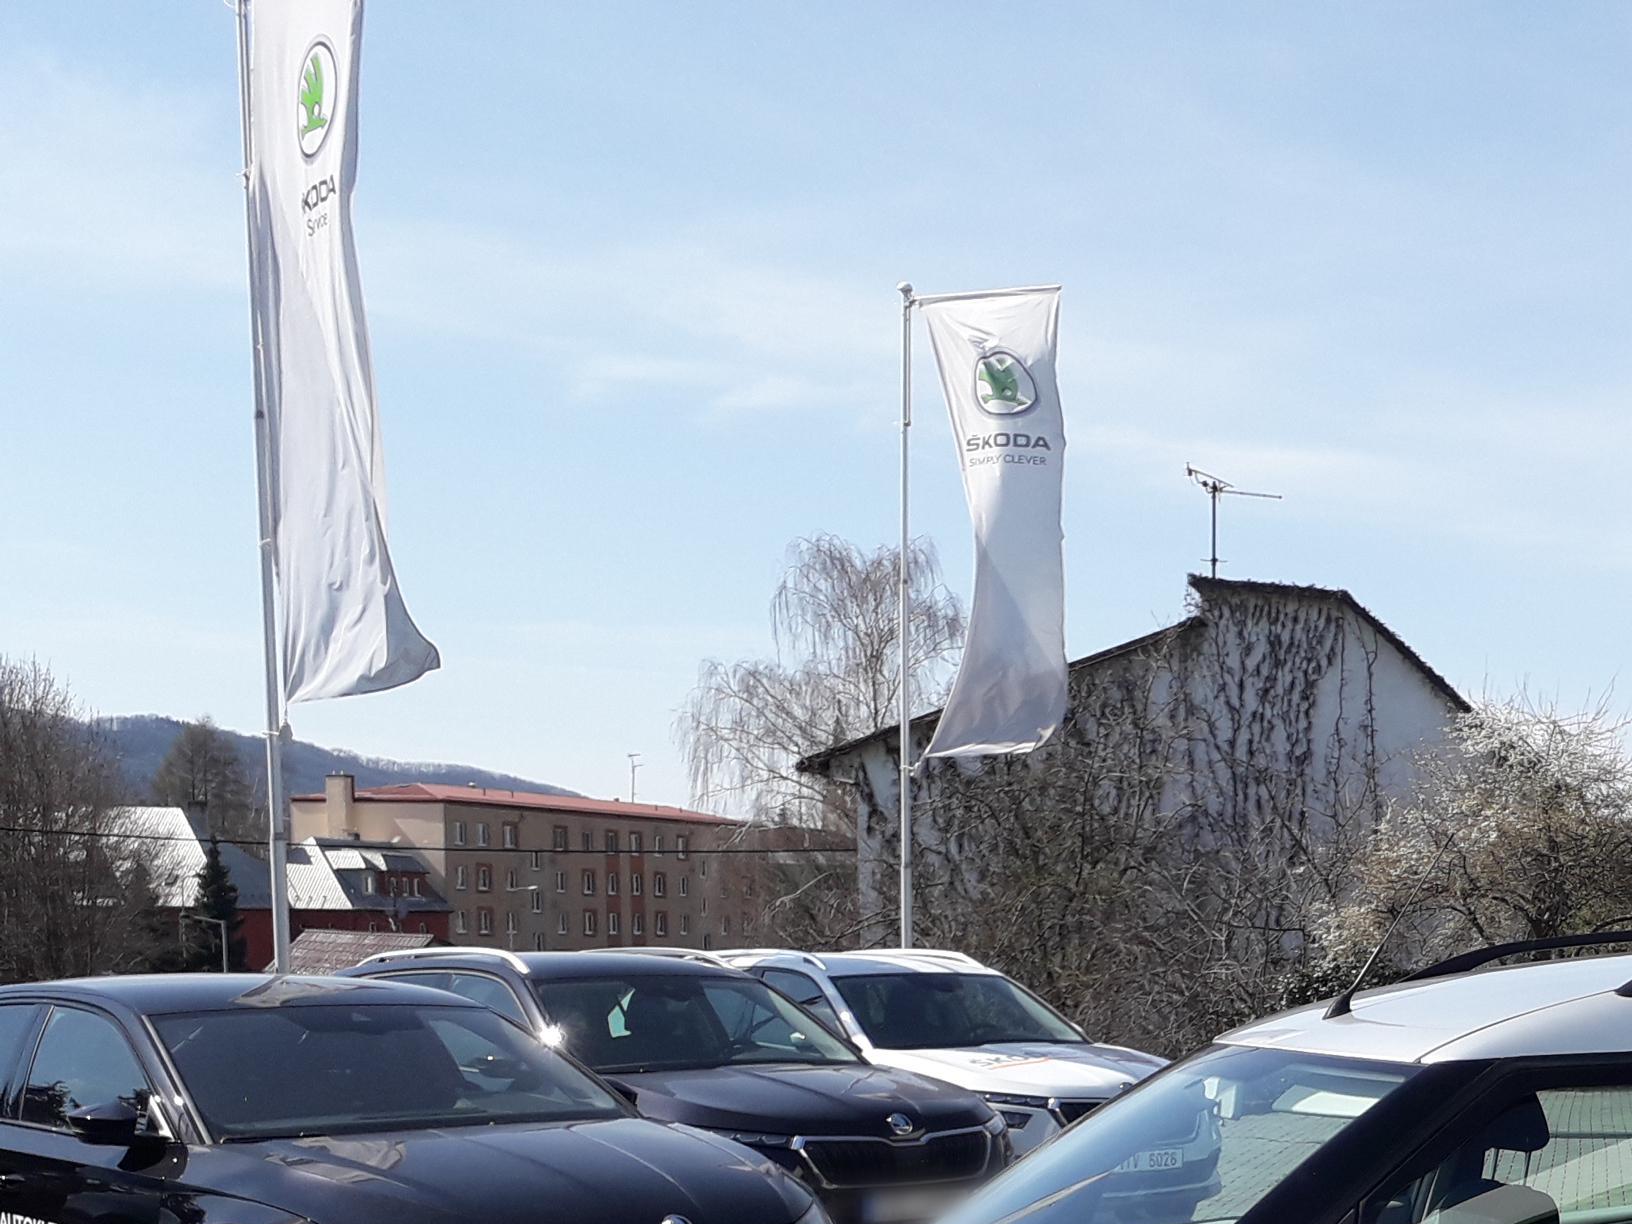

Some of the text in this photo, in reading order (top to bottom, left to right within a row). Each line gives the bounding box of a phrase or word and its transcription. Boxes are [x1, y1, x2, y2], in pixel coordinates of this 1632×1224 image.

[301, 174, 337, 216] KODA
[966, 433, 1052, 452] ŠKODA
[969, 454, 1048, 467] SIMPLY CLEVER
